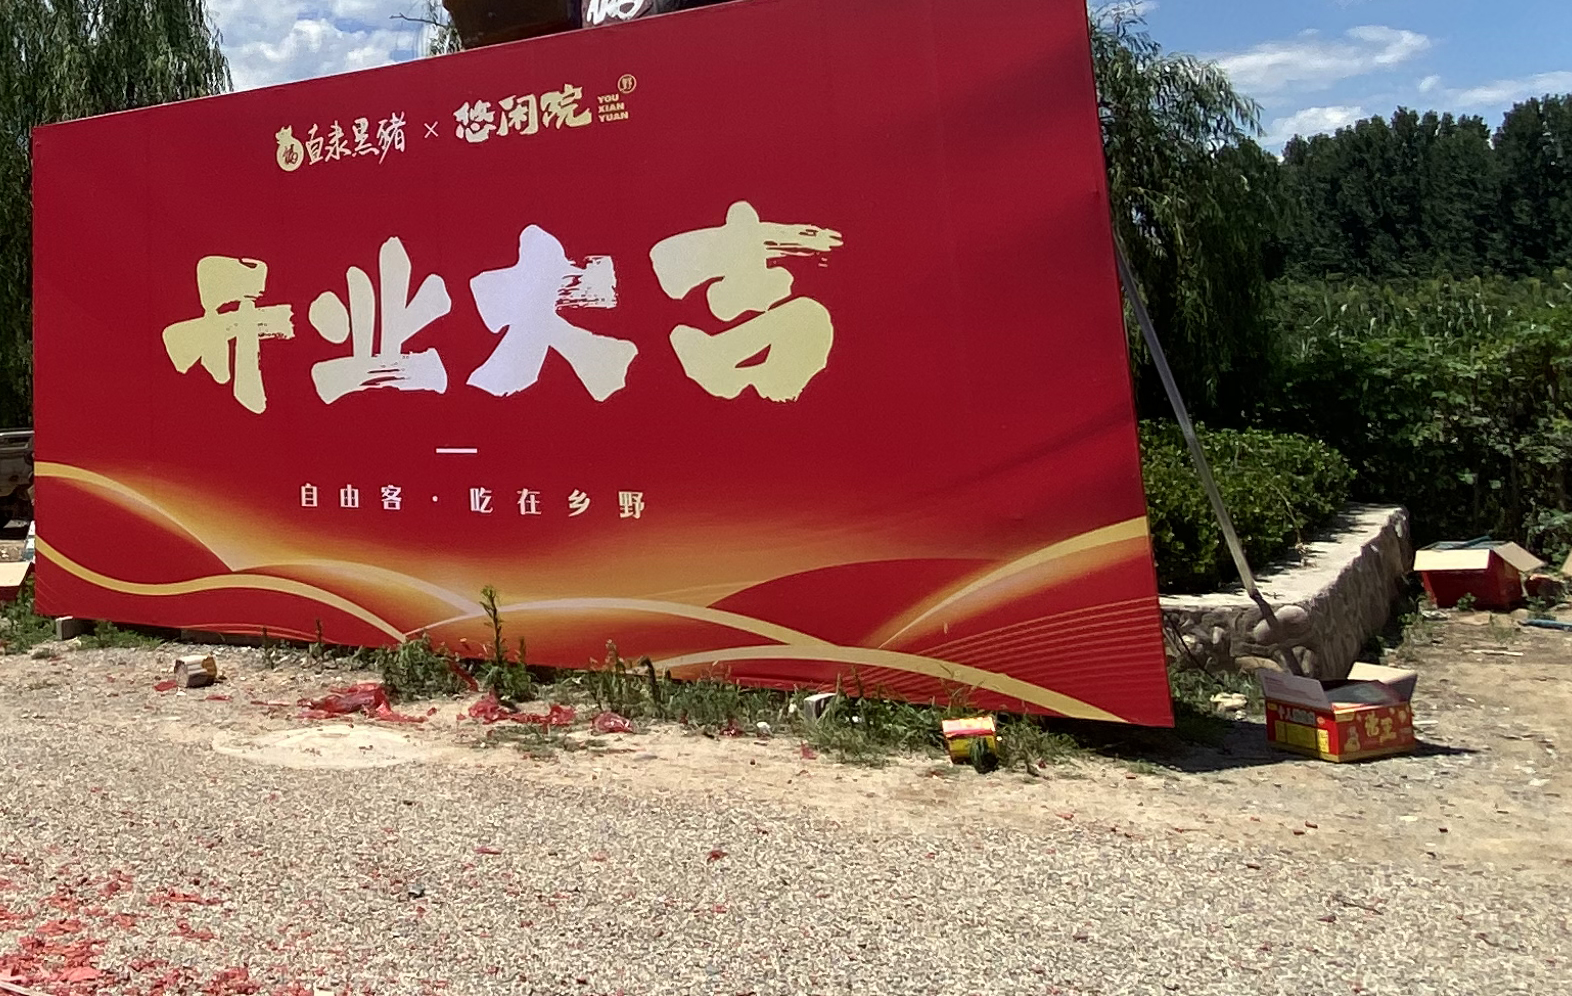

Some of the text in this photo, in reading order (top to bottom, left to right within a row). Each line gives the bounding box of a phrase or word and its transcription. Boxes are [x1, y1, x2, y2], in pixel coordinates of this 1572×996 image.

[597, 94, 619, 104] YOU
[598, 103, 624, 113] XIAN
[454, 84, 593, 144] 悠闲院
[598, 111, 628, 122] YUAN
[162, 201, 844, 415] 开业大吉
